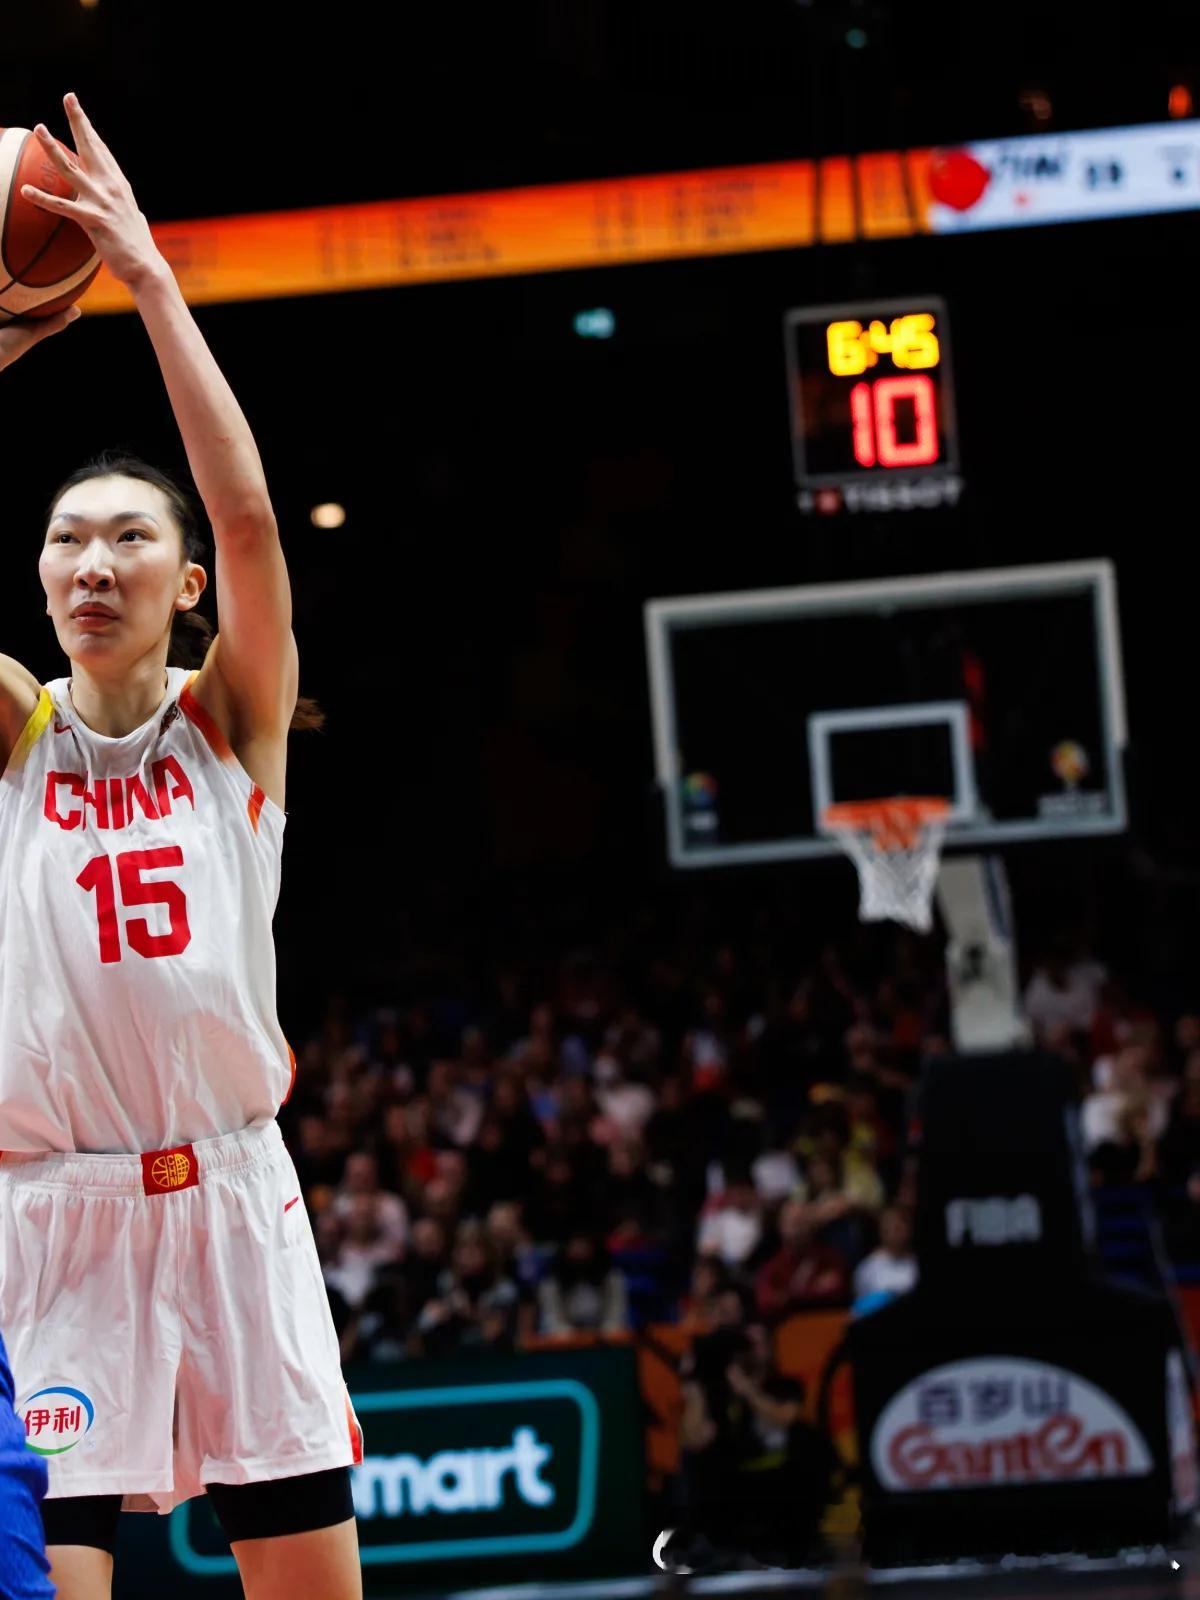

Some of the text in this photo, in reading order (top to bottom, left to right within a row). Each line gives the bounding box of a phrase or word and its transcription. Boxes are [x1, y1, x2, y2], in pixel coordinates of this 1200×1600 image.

[851, 374, 939, 468] 10
[44, 754, 195, 831] CHINA
[76, 845, 192, 963] 15
[166, 1154, 178, 1187] CHN
[24, 1405, 81, 1437] 伊利
[352, 1426, 555, 1518] mart
